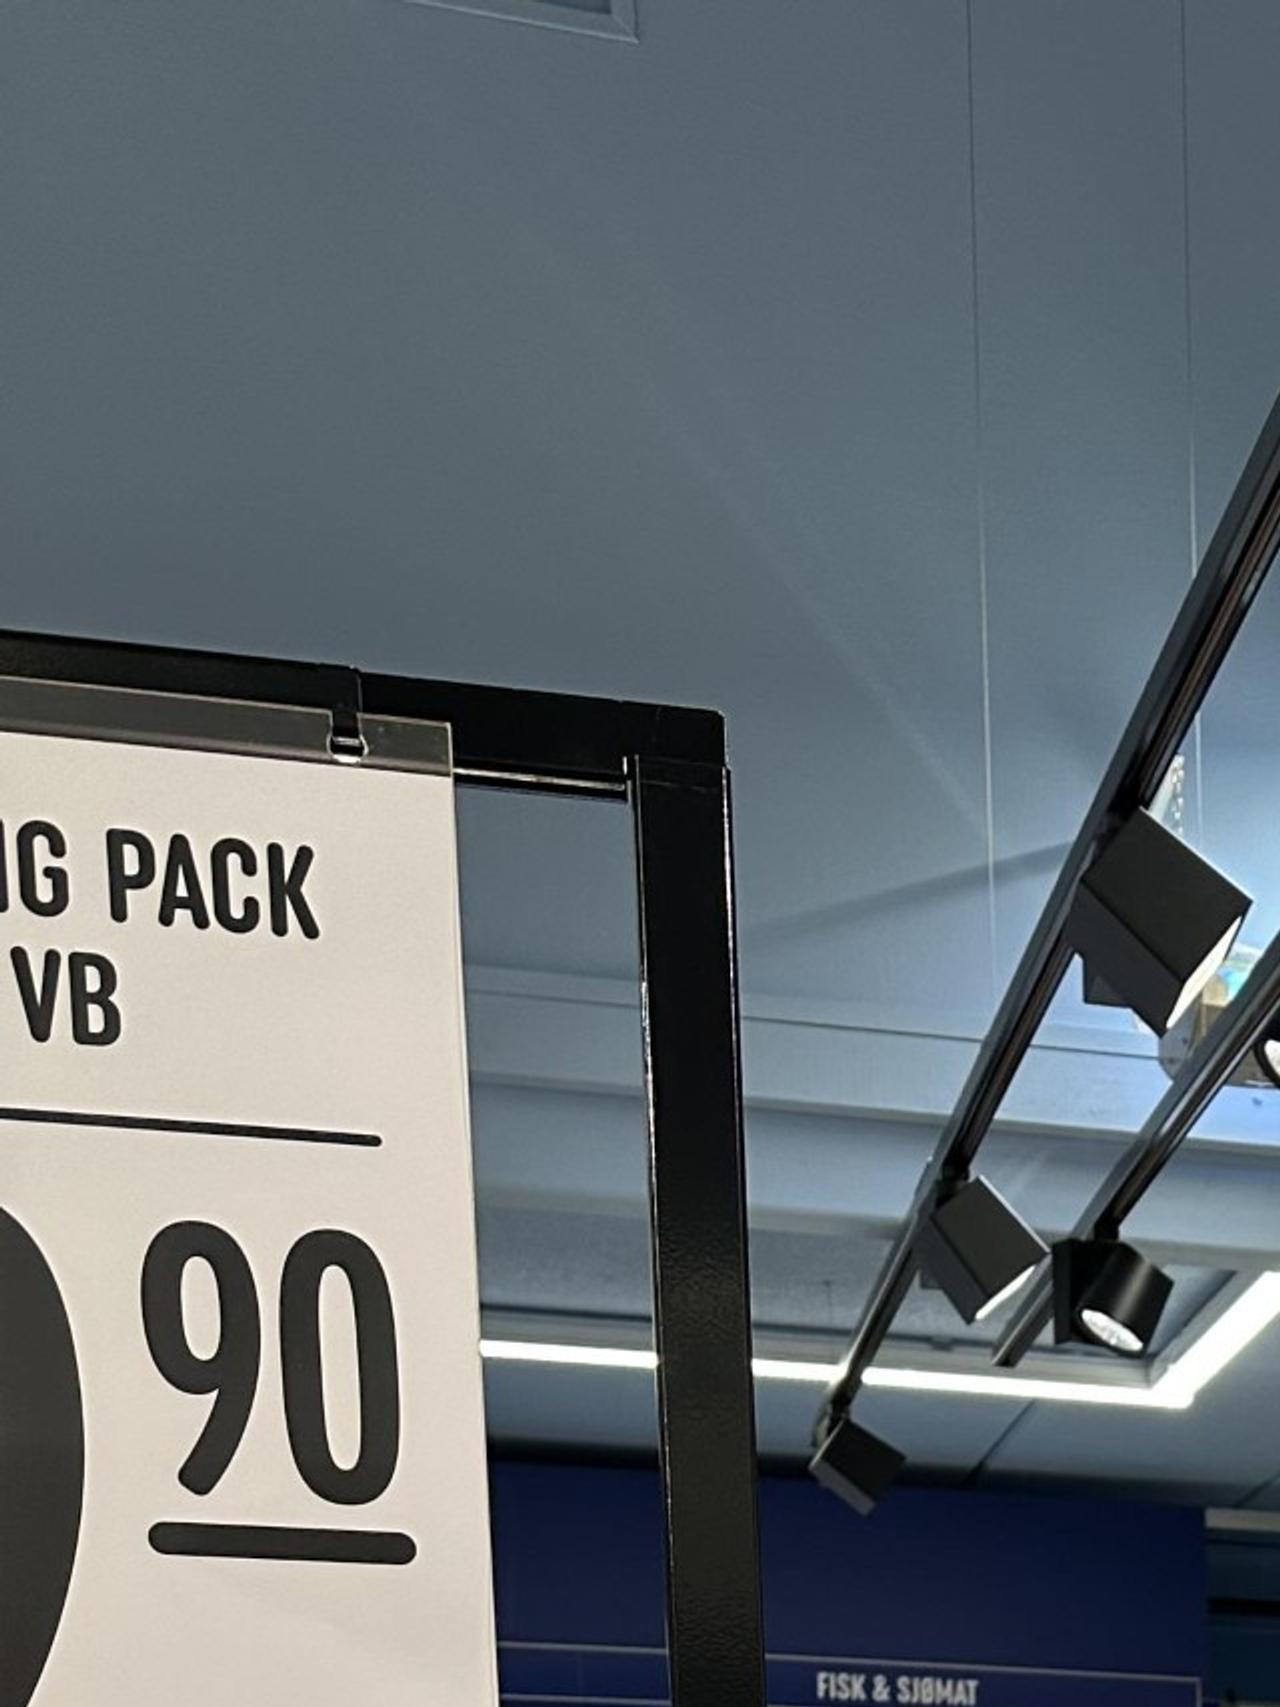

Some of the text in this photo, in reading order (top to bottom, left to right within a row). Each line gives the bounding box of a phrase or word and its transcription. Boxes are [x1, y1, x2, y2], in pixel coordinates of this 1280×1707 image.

[0, 818, 320, 940] G PACK
[10, 946, 121, 1046] VB
[140, 1220, 400, 1505] 90
[816, 1672, 979, 1705] FISK & SJØMAT
